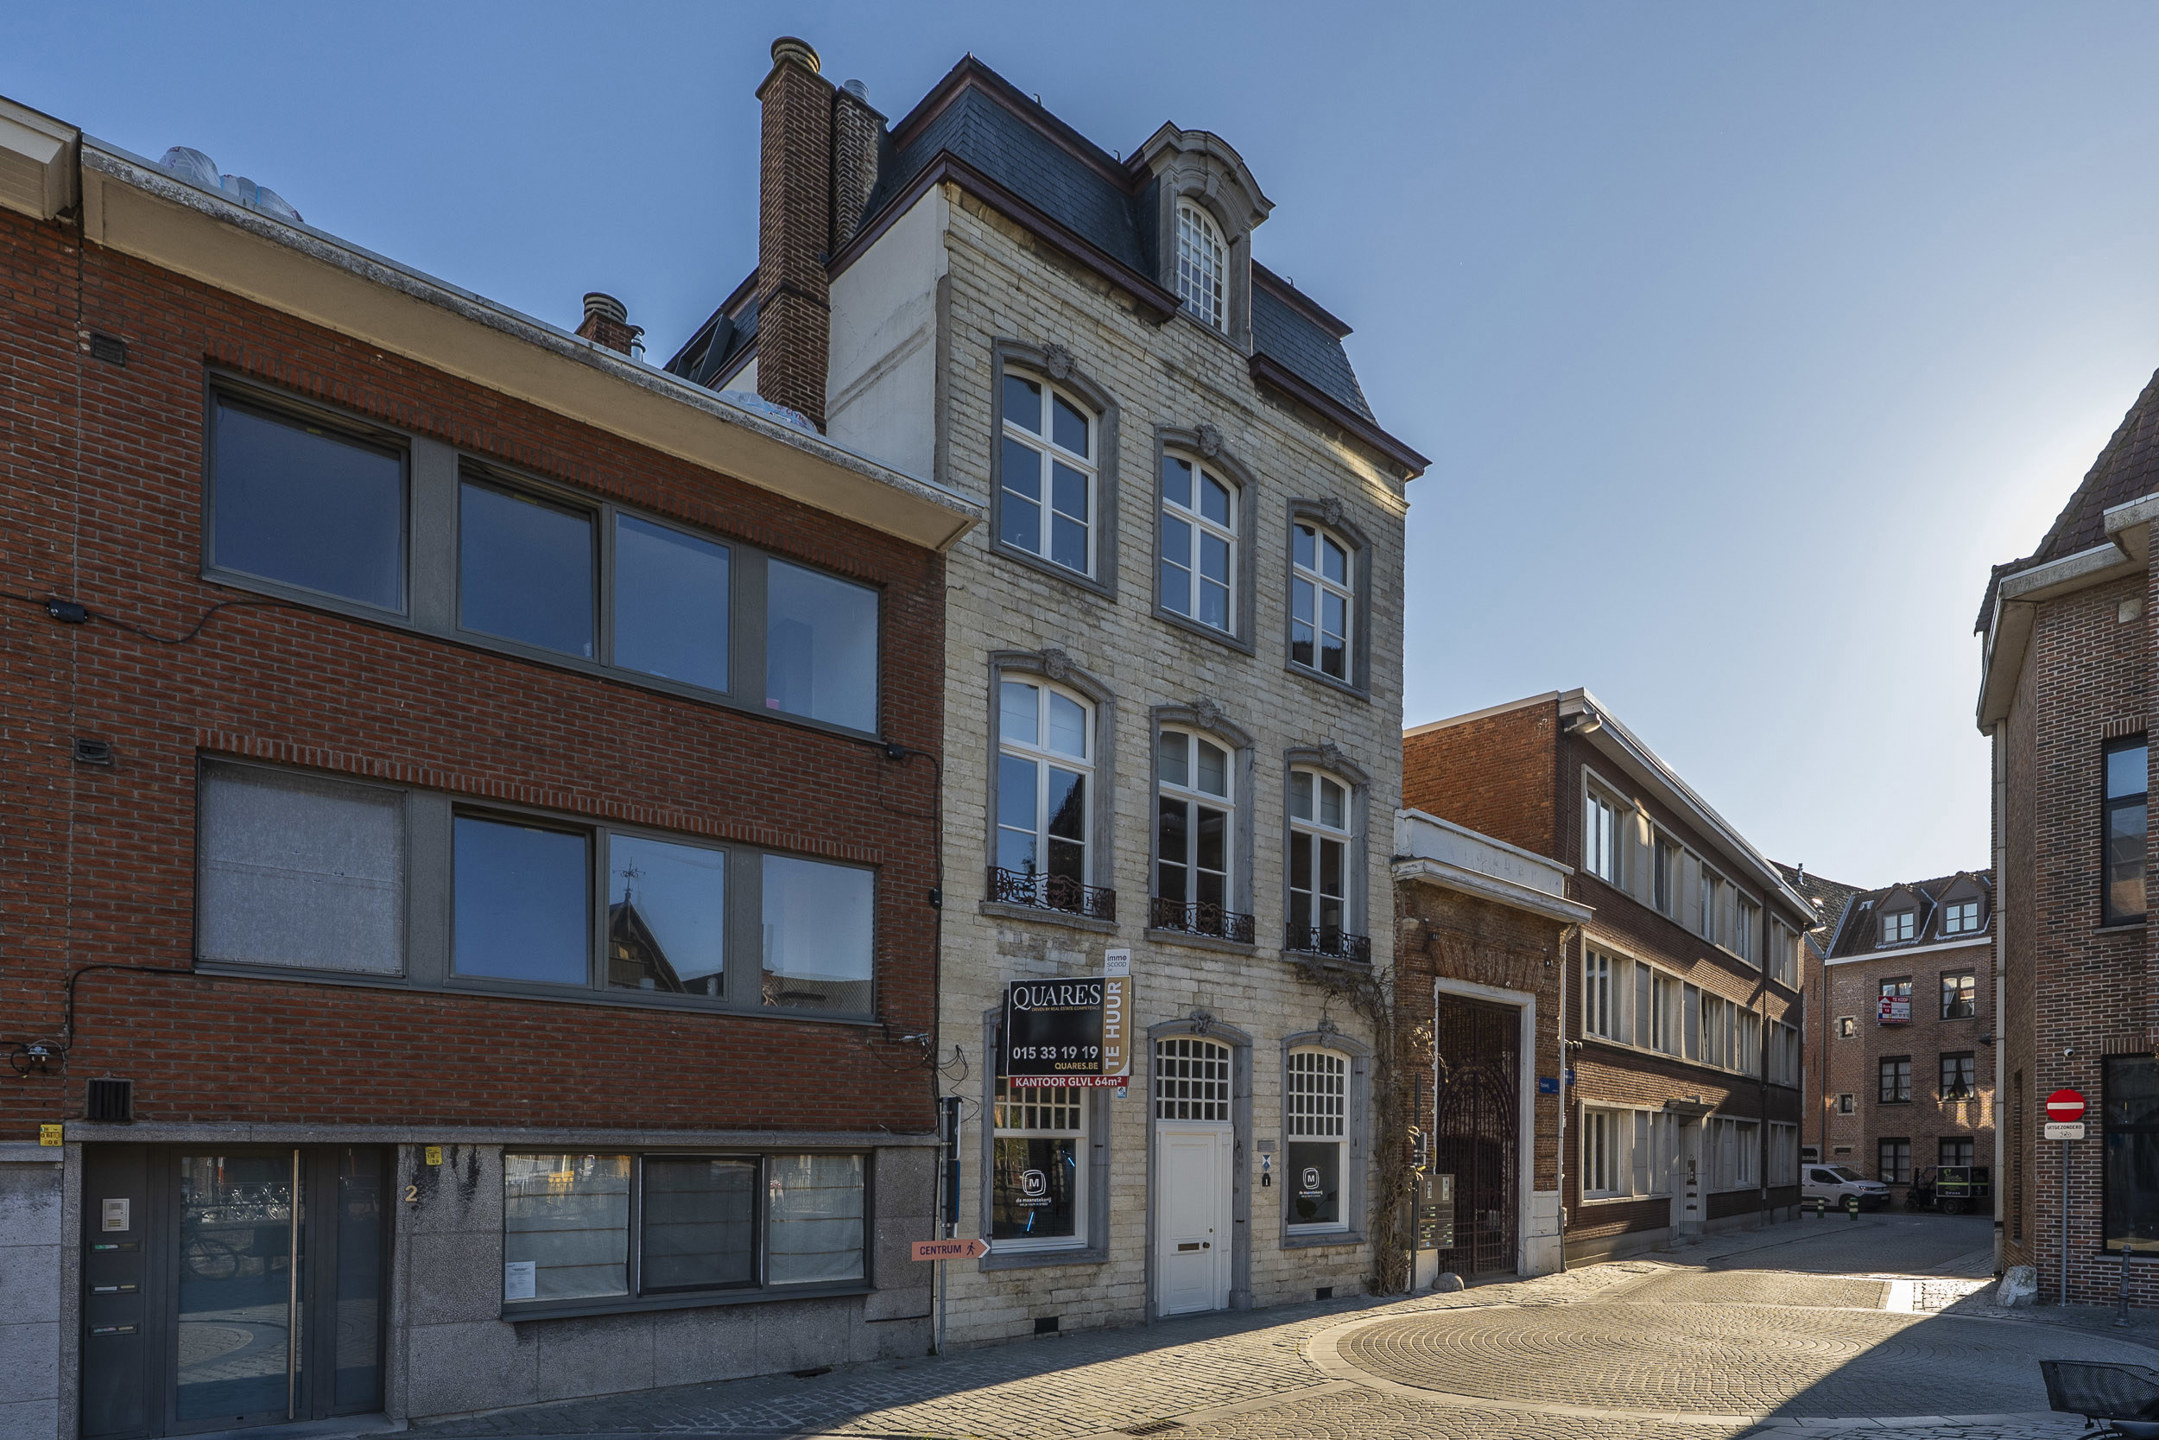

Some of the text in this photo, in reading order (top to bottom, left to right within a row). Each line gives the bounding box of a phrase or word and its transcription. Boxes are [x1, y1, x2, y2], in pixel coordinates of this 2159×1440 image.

[1013, 984, 1101, 1011] QUARES
[1105, 981, 1122, 1070] TE HUUR
[1013, 1046, 1099, 1060] 015 33 19 19
[1054, 1062, 1099, 1070] QUARES.BE
[1015, 1076, 1122, 1087] KANTOOR GLVL 64m²
[1029, 1179, 1039, 1187] M
[1307, 1175, 1315, 1183] M
[404, 1185, 418, 1202] 2
[920, 1244, 962, 1256] CENTRUM
